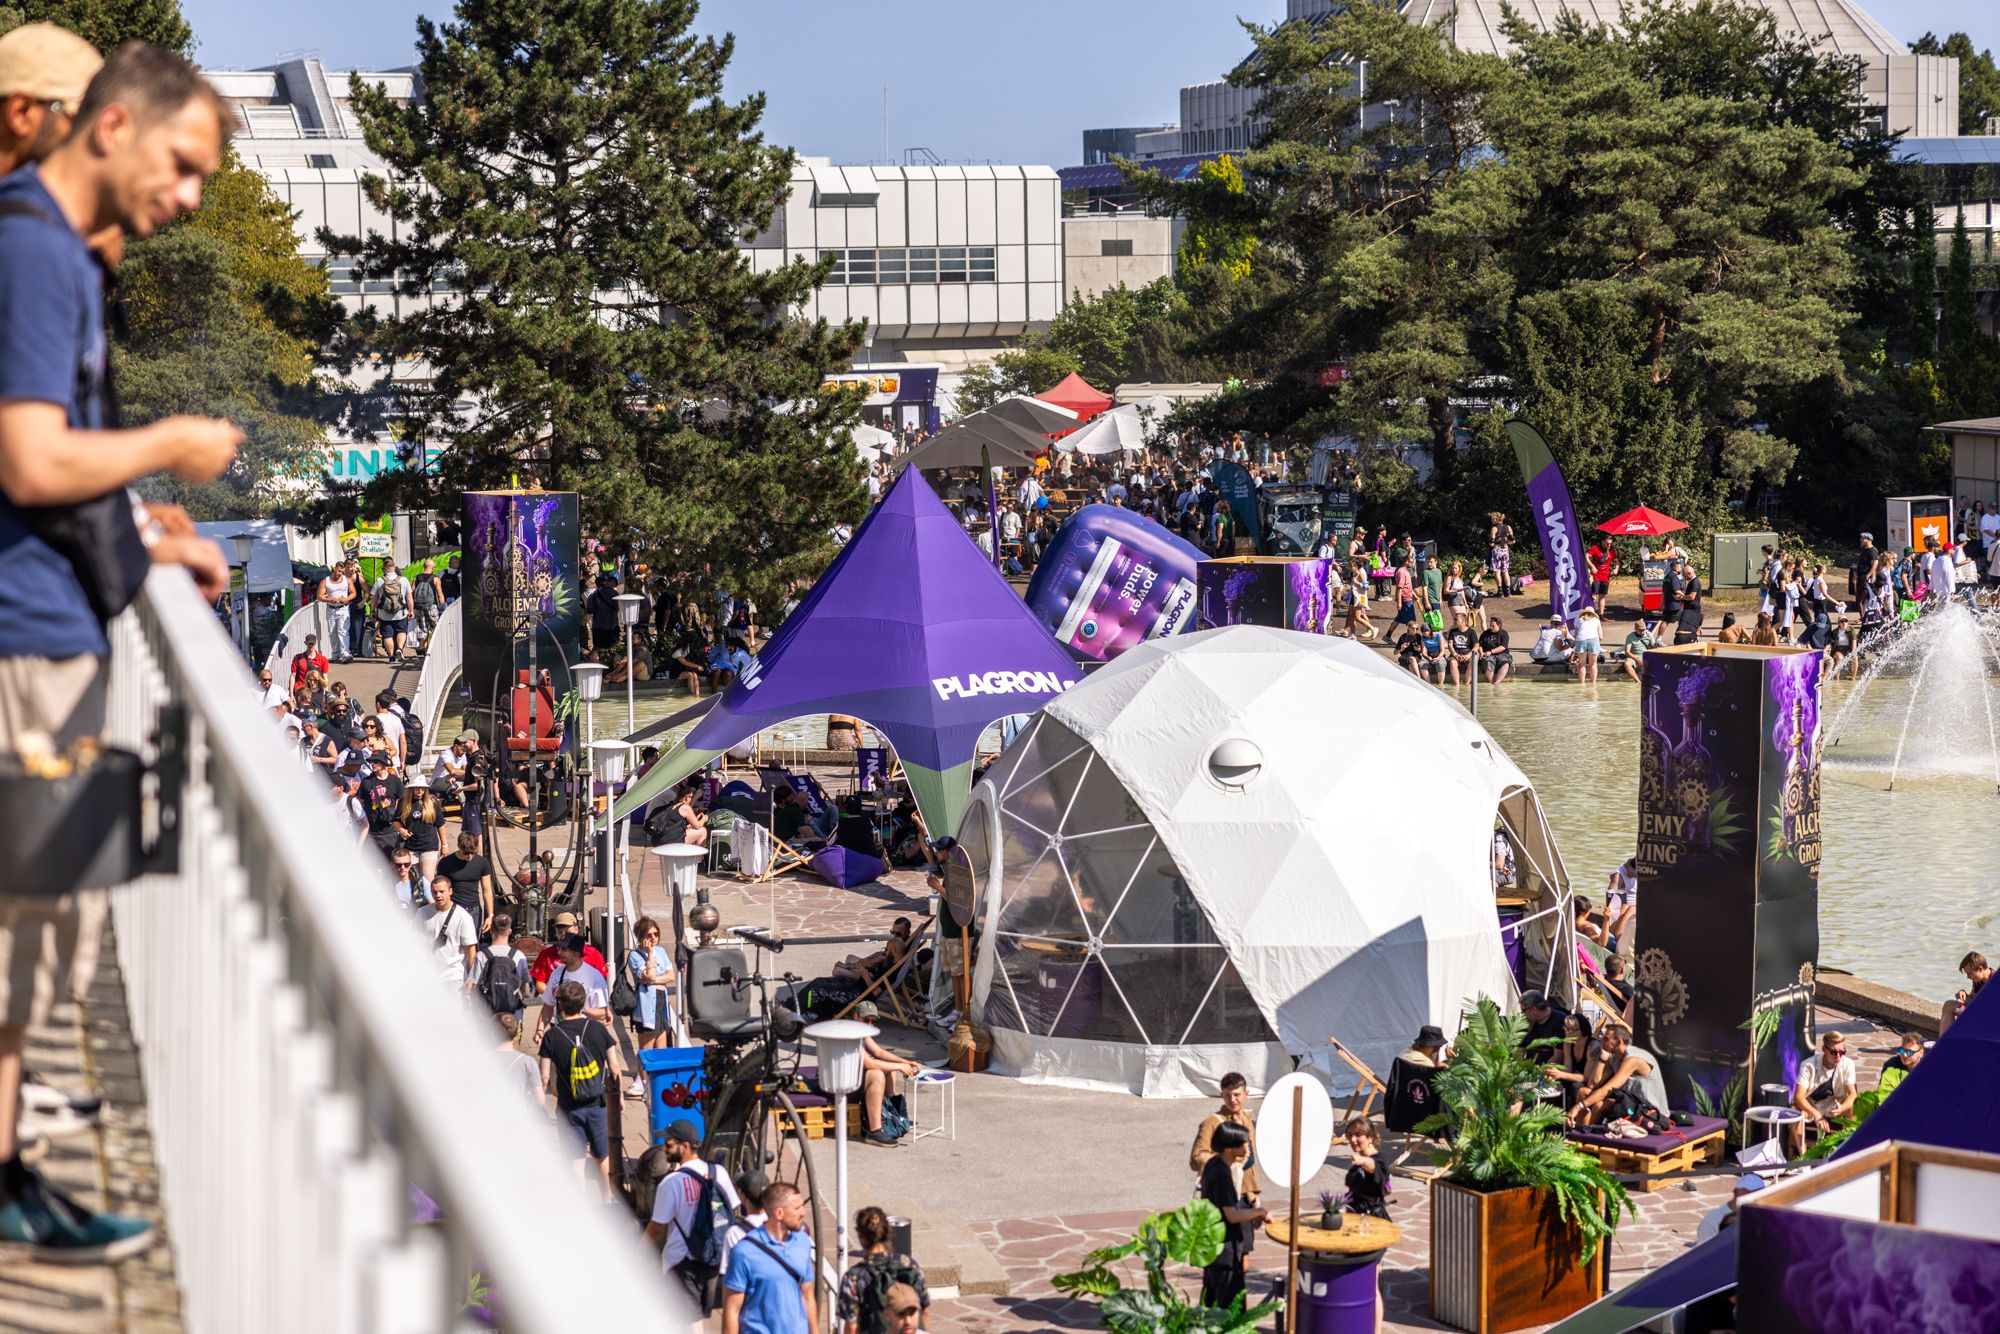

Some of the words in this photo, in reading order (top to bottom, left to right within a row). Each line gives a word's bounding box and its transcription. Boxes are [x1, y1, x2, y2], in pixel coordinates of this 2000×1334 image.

[1118, 562, 1146, 601] buds.
[1129, 571, 1158, 616] power
[492, 597, 541, 611] ALCHEMY
[494, 616, 538, 629] GROWIN
[1640, 813, 1686, 838] EMY
